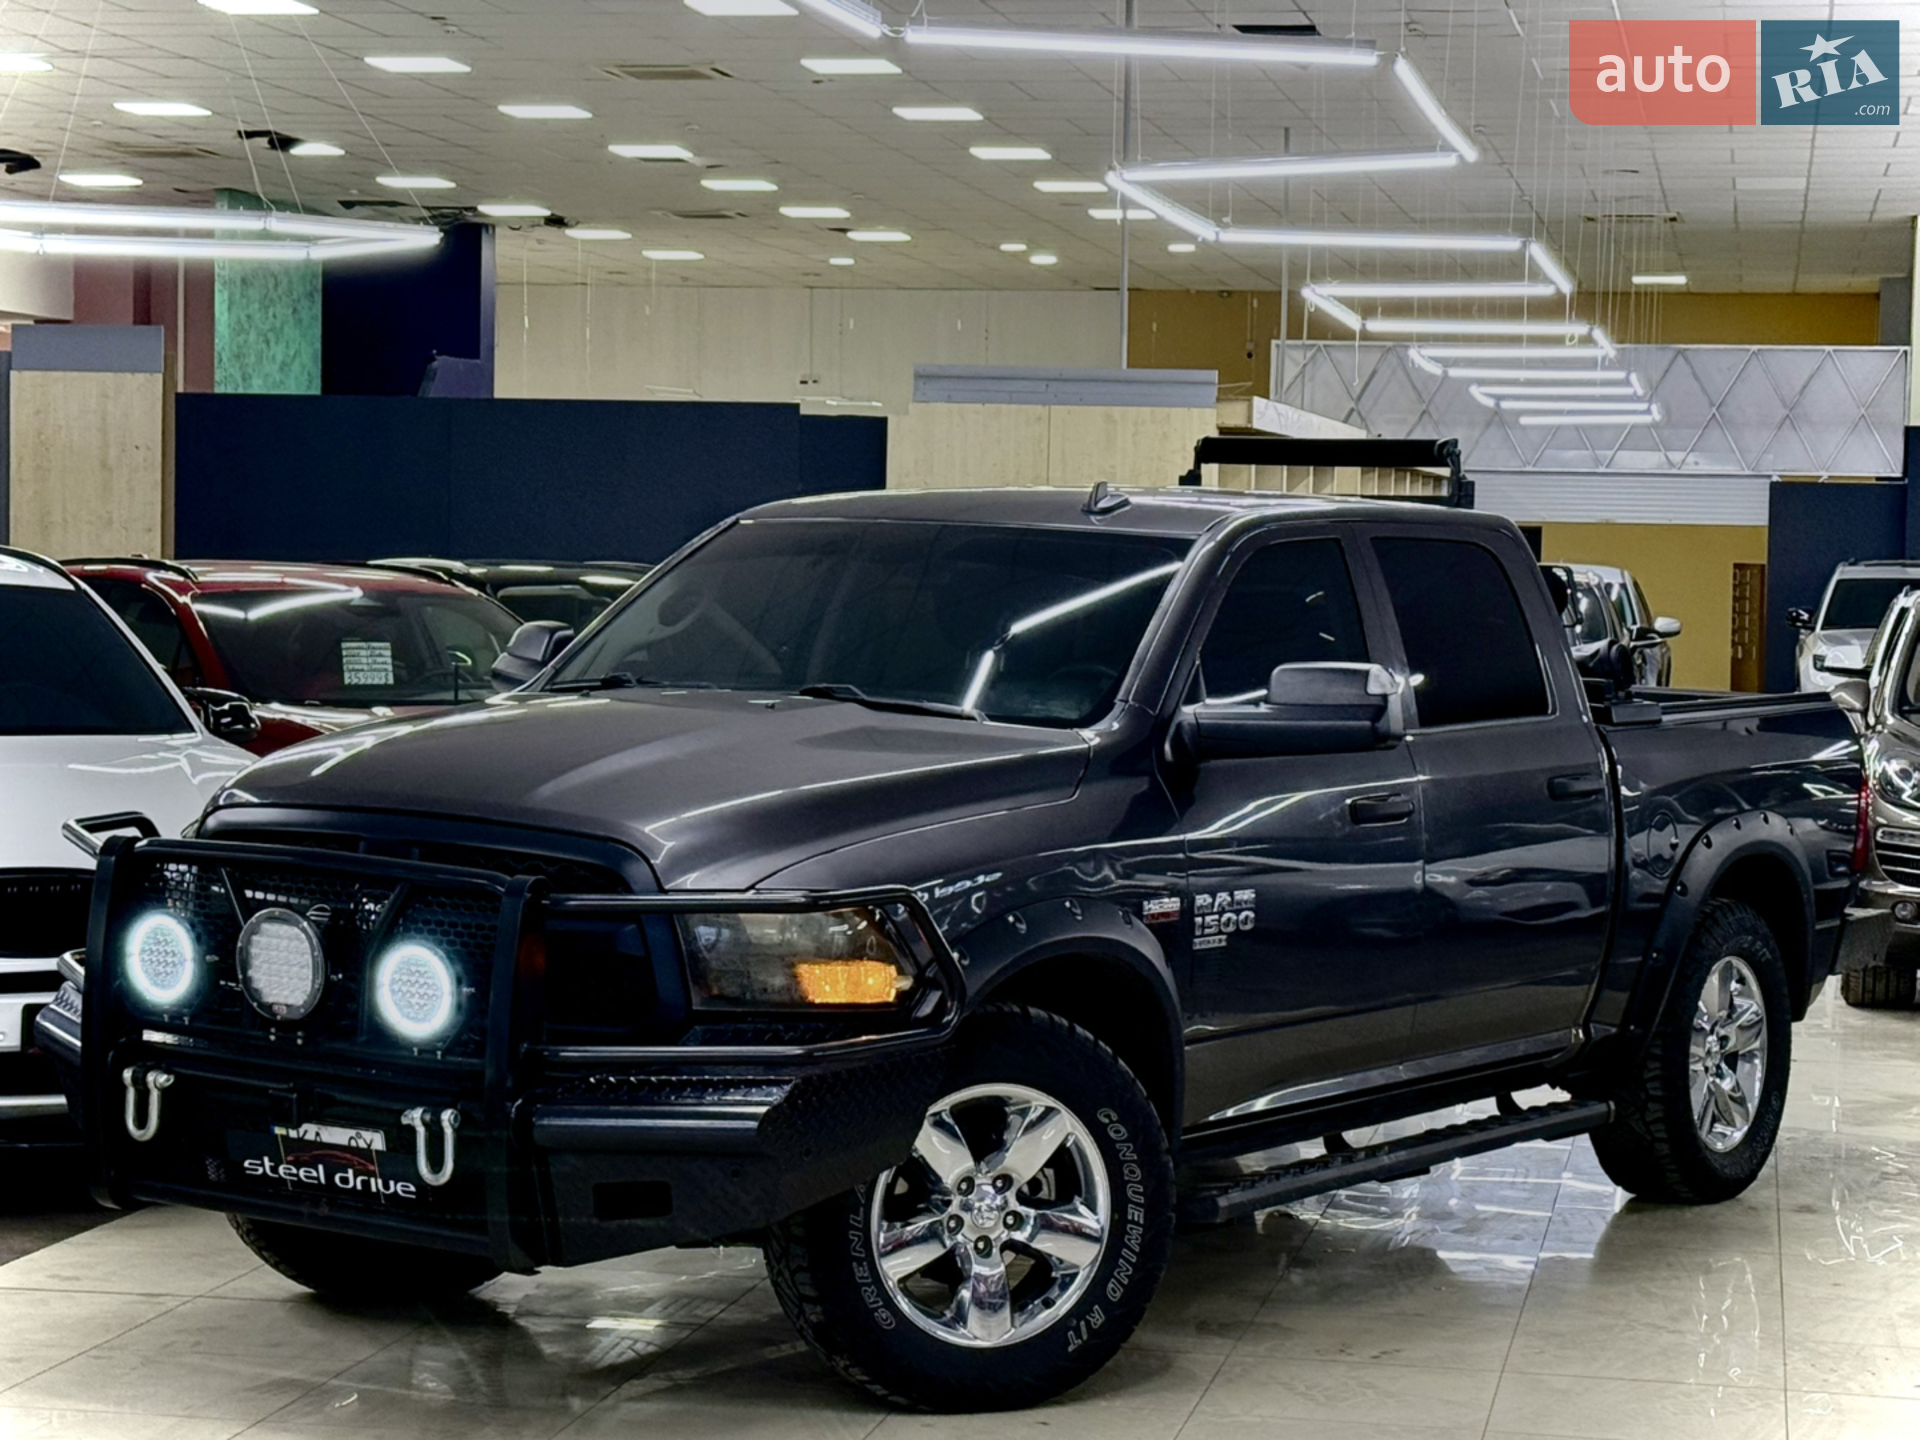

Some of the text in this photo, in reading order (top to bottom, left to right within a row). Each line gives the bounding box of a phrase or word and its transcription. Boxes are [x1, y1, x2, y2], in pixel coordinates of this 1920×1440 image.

[1194, 888, 1256, 915] RAM
[1194, 910, 1256, 936] 1500
[243, 1155, 417, 1199] steel drive
[1067, 1107, 1145, 1353] CONQUEWIND R/T
